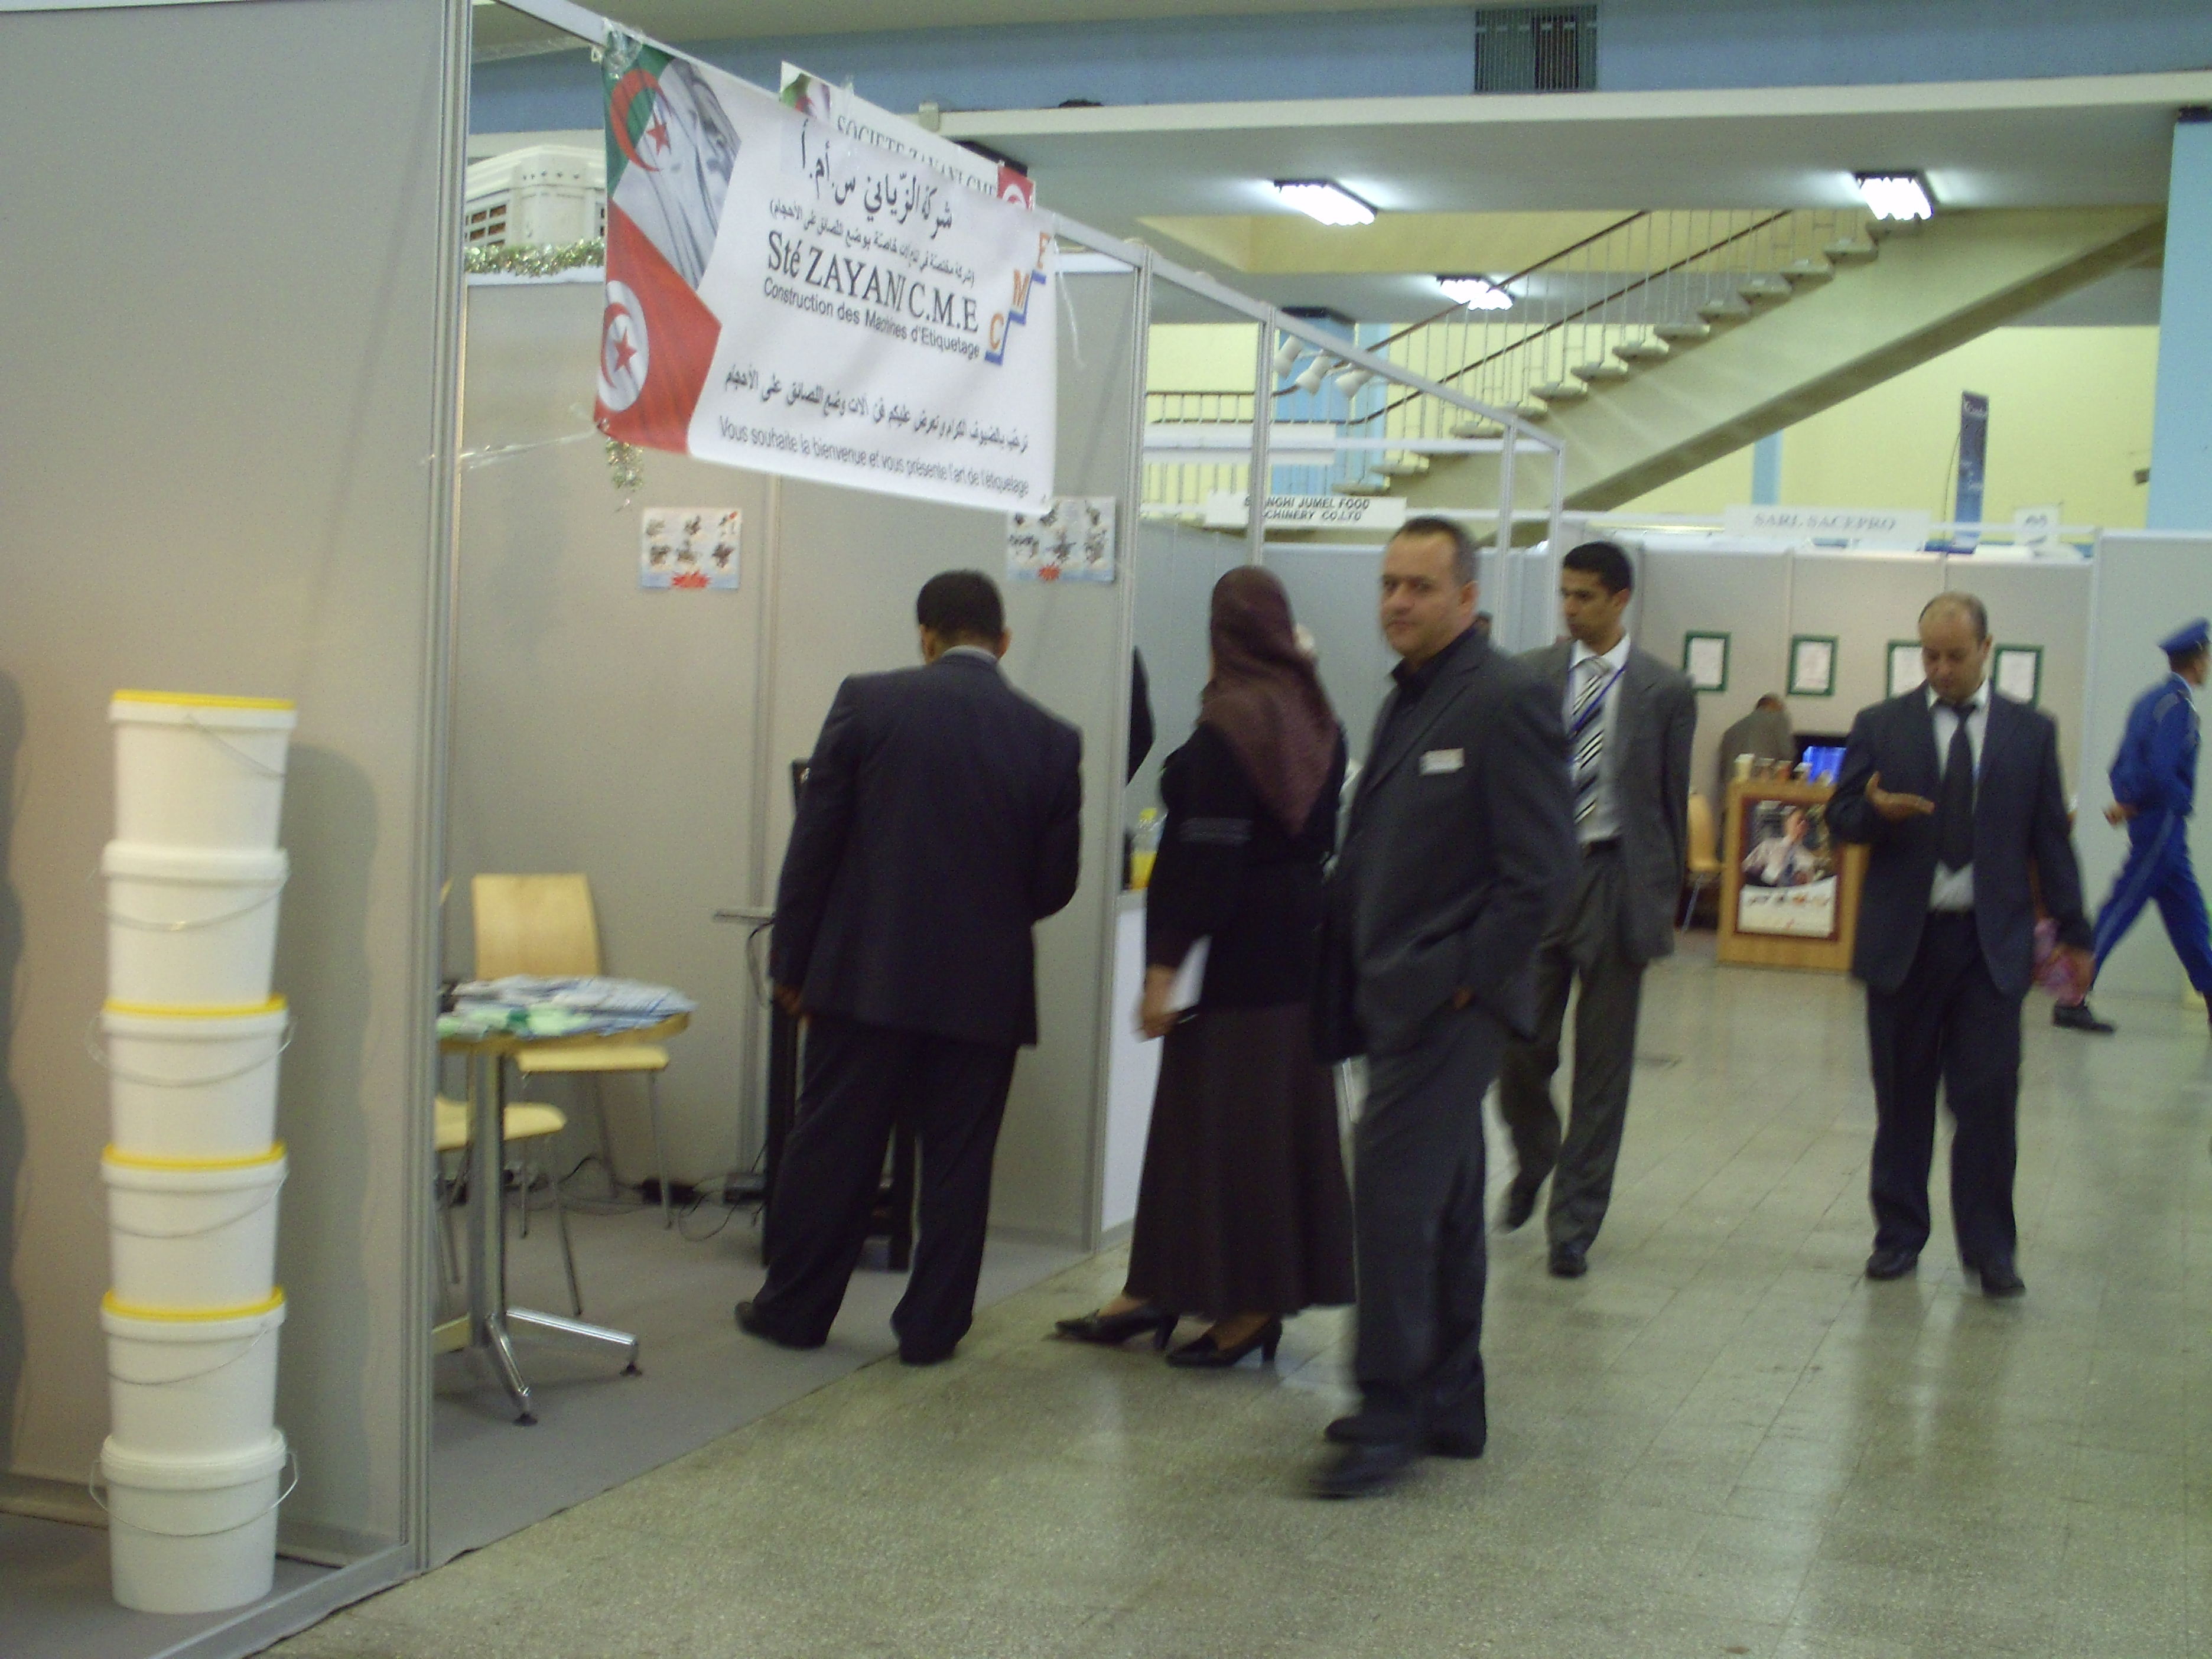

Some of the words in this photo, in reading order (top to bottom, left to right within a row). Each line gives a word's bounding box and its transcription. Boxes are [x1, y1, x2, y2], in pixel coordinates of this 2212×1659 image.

[763, 276, 834, 318] Construction
[837, 301, 861, 326] des
[768, 229, 803, 278] Sté
[909, 281, 979, 334] C.M.E
[888, 404, 911, 428] عليكم
[720, 415, 749, 443] Vous
[751, 428, 798, 453] souhaite
[801, 432, 811, 455] la
[813, 436, 867, 466] bienvenue
[869, 450, 880, 467] et
[882, 454, 905, 473] vous
[968, 467, 980, 486] de
[1338, 497, 1370, 510] FOOD
